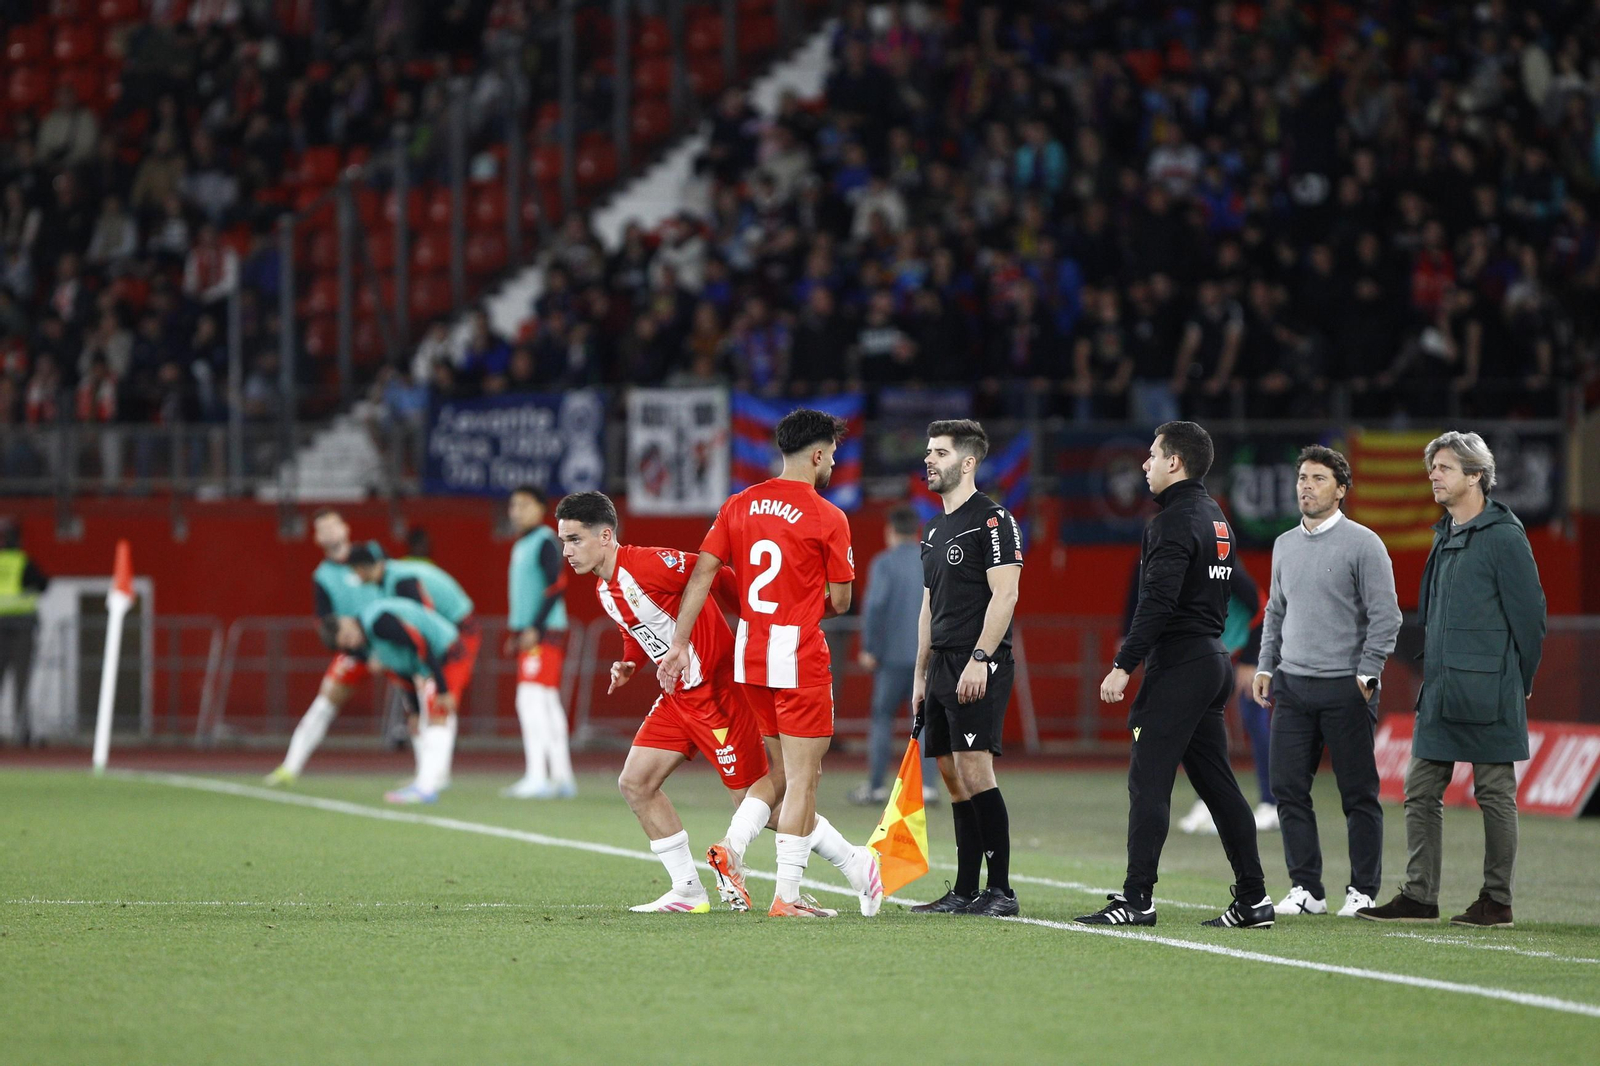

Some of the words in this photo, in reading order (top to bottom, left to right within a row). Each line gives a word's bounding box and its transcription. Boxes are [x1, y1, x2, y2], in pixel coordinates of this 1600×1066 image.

[749, 499, 803, 524] ARNAU
[747, 539, 782, 614] 2
[717, 754, 737, 764] KUDU
